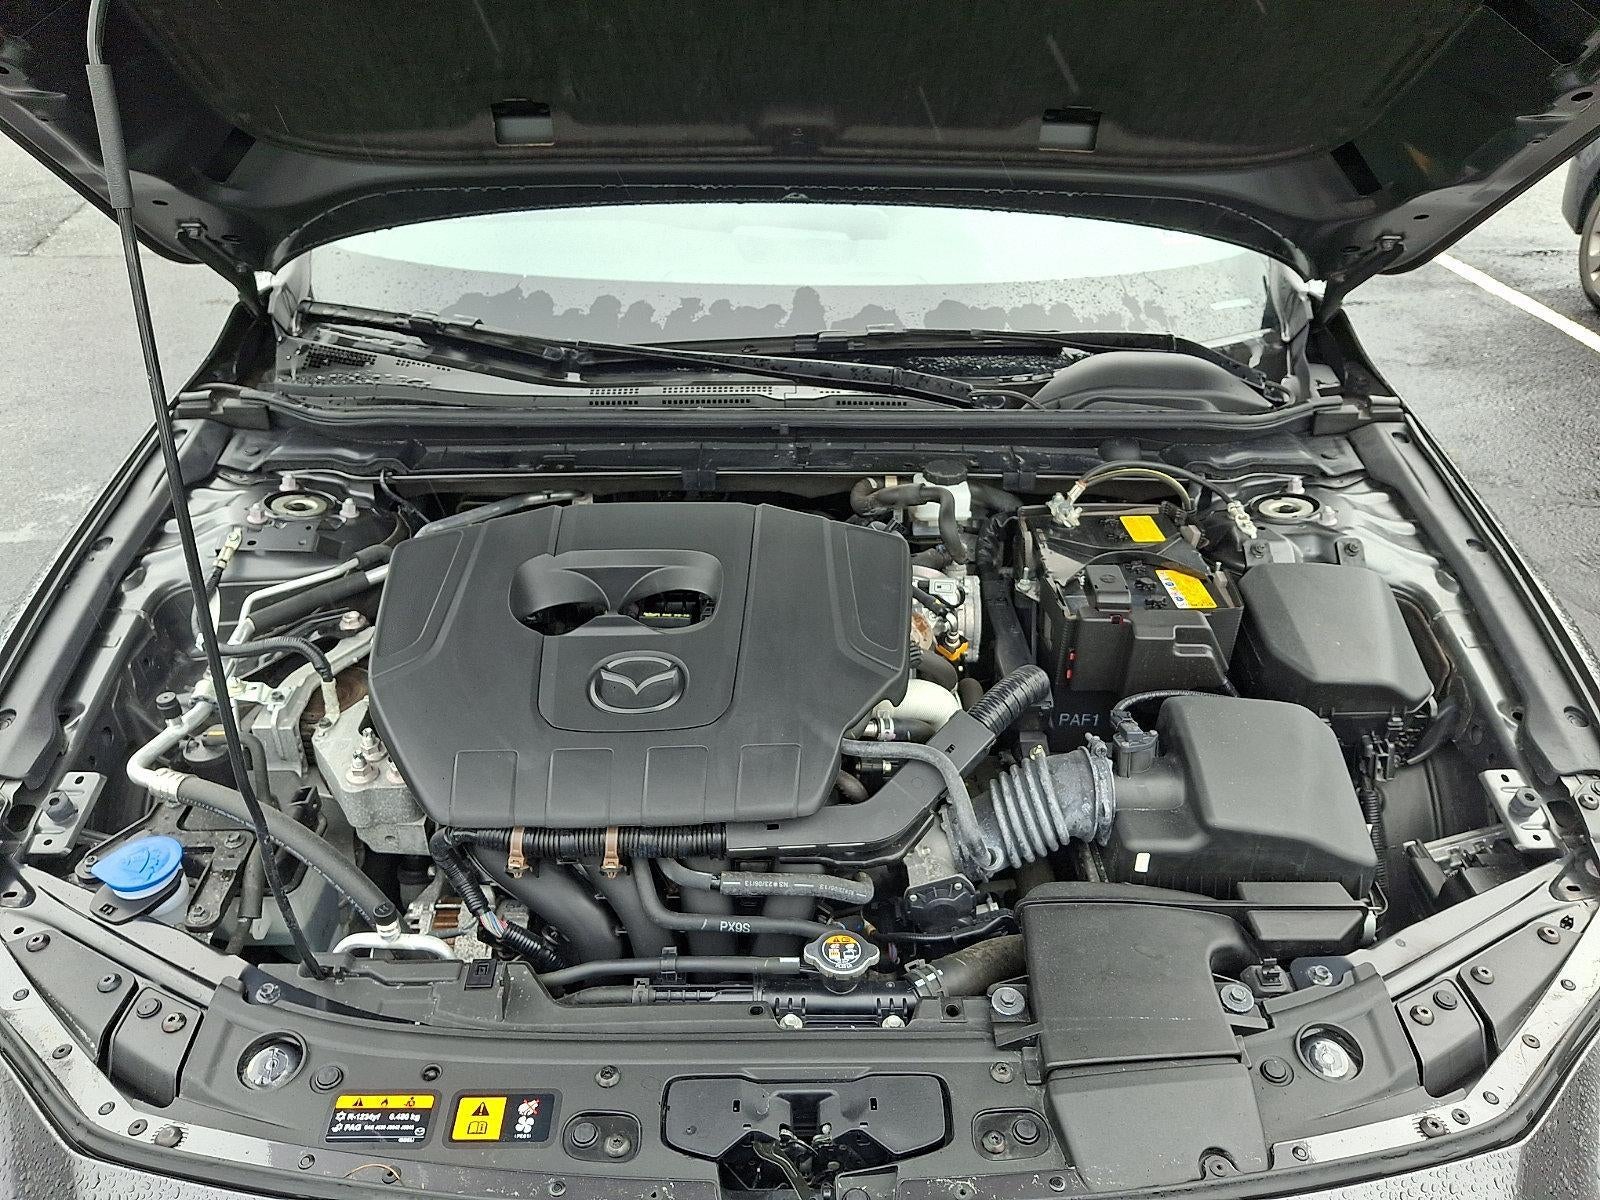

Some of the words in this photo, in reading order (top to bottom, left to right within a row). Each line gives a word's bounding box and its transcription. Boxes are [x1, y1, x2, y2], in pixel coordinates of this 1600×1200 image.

[1059, 713, 1099, 726] PAF1
[720, 920, 751, 932] PX9S
[343, 1123, 362, 1132] PAG
